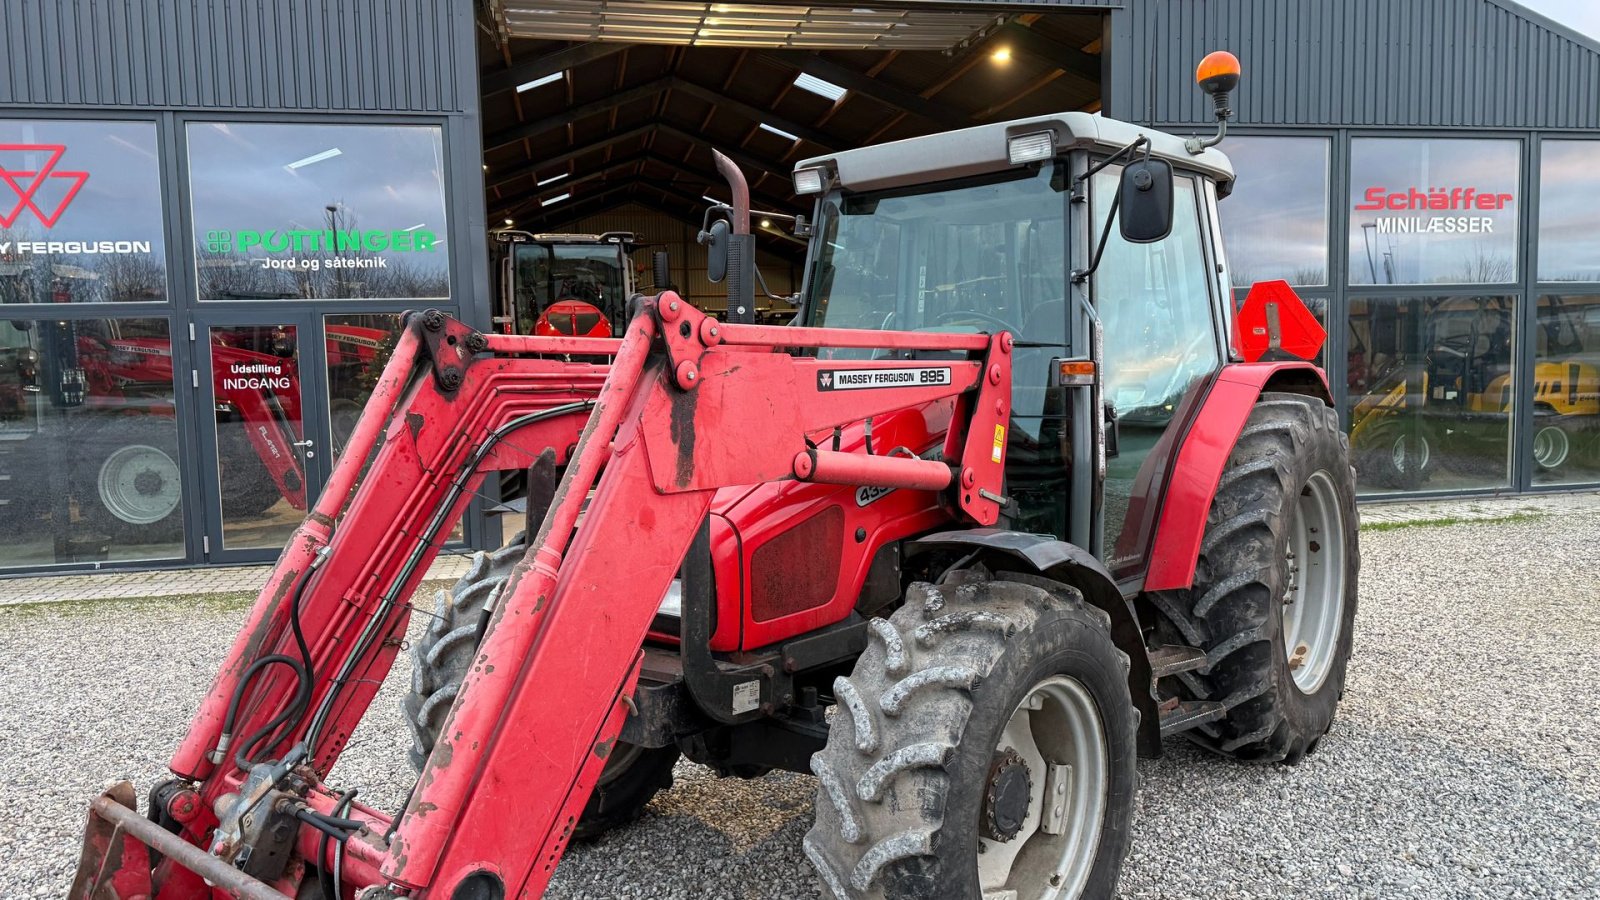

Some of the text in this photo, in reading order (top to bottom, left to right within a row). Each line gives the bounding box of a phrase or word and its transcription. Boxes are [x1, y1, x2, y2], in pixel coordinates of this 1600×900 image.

[1354, 186, 1513, 210] Schäffer
[1376, 216, 1493, 233] MINILÆSSER
[16, 240, 151, 254] FERGUSON
[262, 256, 387, 271] Jord og såteknik
[230, 364, 281, 375] Udstilling
[223, 377, 290, 390] INDGANG
[839, 370, 945, 385] MASSEY FERGUSON 895
[860, 486, 888, 502] 43
